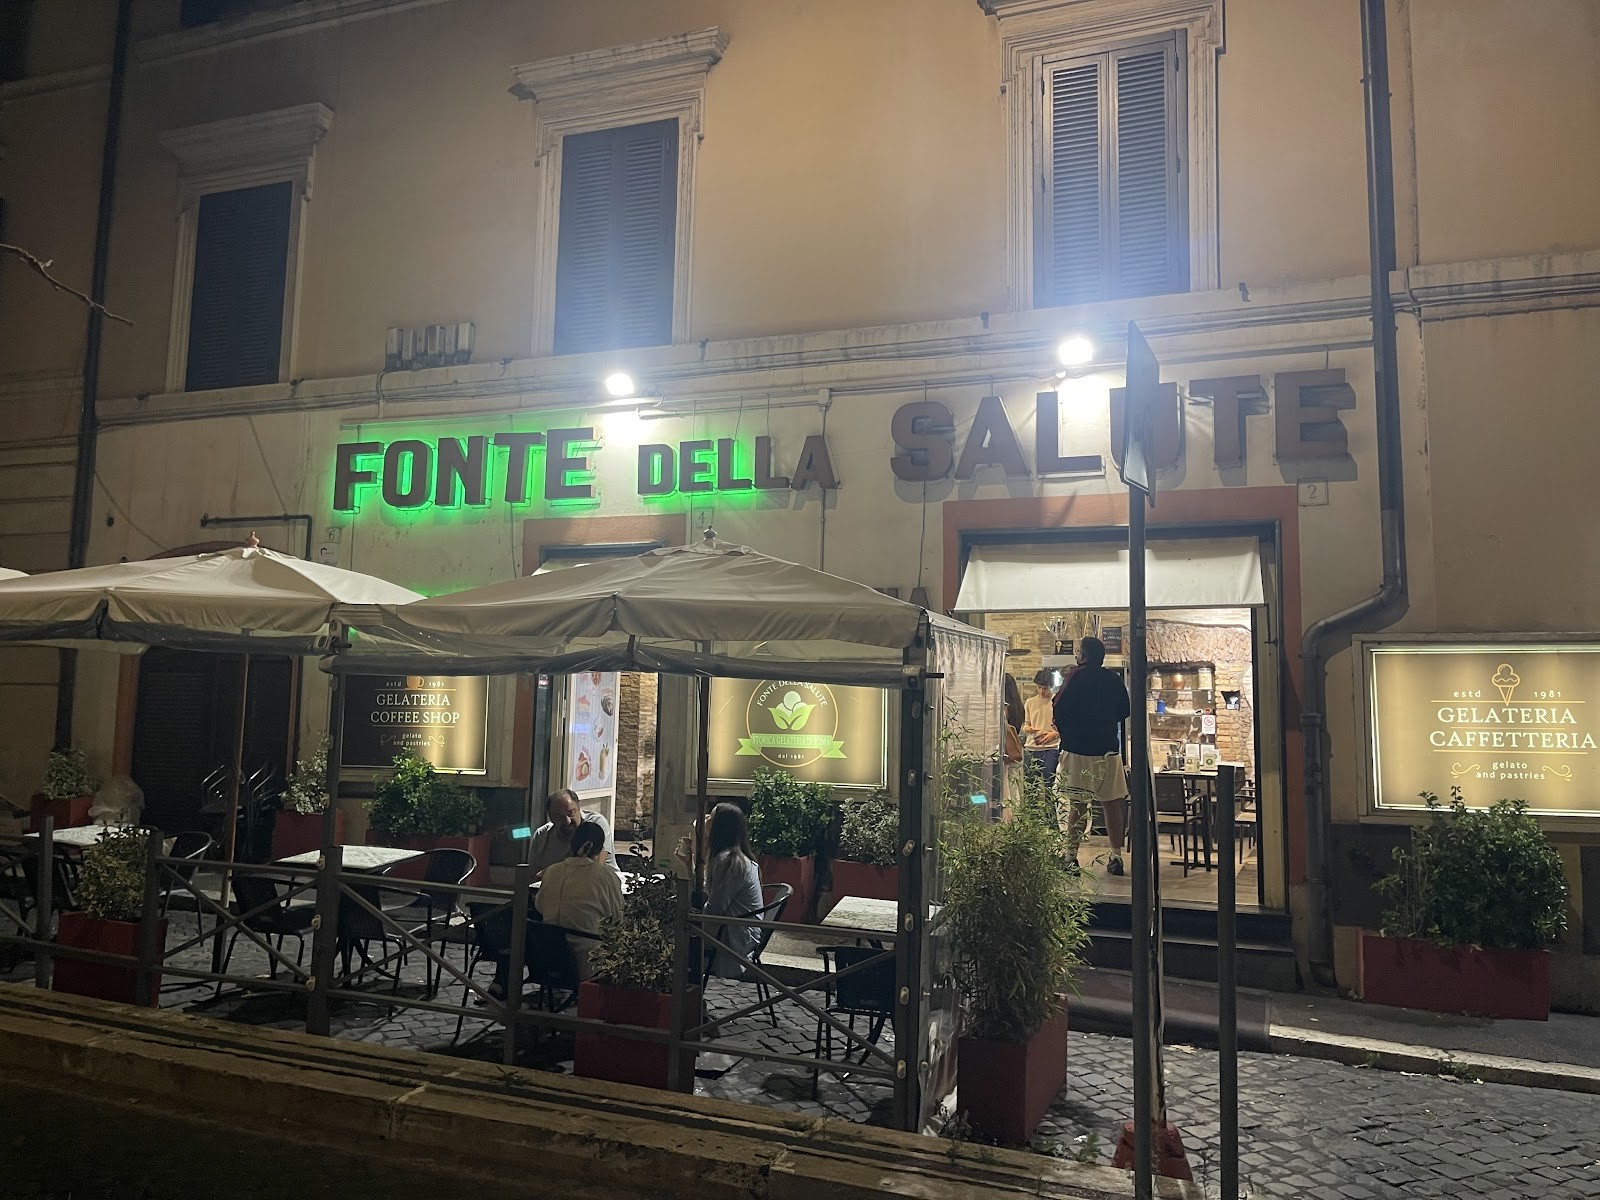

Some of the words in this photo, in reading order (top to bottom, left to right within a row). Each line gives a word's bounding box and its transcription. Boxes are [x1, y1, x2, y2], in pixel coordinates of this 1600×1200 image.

[333, 427, 598, 511] FONTE
[637, 435, 840, 497] DELLA
[890, 368, 1348, 482] SALUTE
[1307, 484, 1318, 499] 2
[698, 511, 706, 524] 4
[328, 529, 336, 541] 6
[376, 694, 451, 706] GELATERIA
[757, 683, 778, 707] FONTE
[803, 681, 829, 708] SALUTE
[1453, 690, 1481, 698] estd
[1533, 691, 1562, 700] 1981
[370, 711, 420, 724] COFFEE
[423, 711, 460, 724] SHOP
[1437, 707, 1577, 724] GELATERIA
[752, 735, 776, 745] STORICA
[776, 736, 806, 746] GELATERIA
[1429, 731, 1598, 749] CAFFETTERIA
[1492, 761, 1528, 770] gelato
[1476, 771, 1496, 779] and
[1500, 772, 1545, 782] pastries
